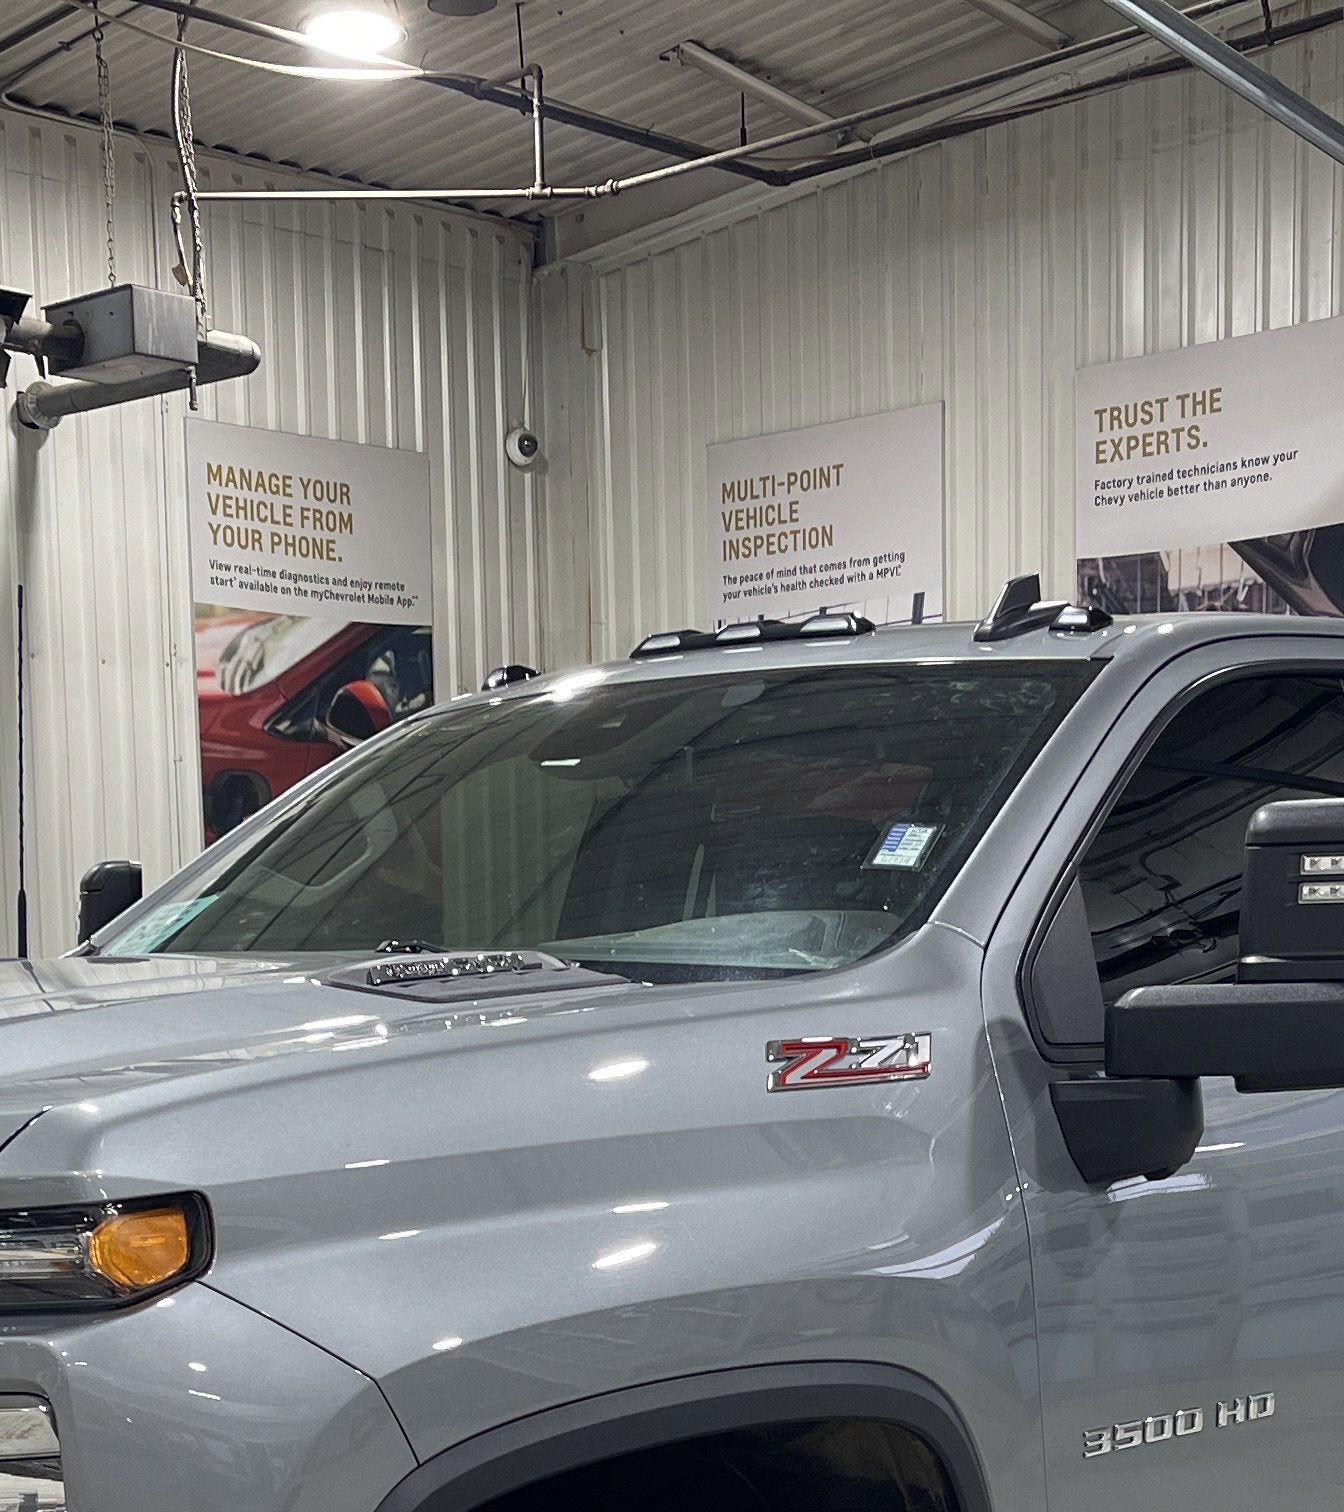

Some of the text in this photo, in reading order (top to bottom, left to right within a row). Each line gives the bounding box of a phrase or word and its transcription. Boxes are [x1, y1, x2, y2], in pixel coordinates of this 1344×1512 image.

[1095, 388, 1222, 432] TRUST THE
[1095, 424, 1208, 465] EXPERTS.
[207, 463, 351, 505] MANAGE YOUR
[721, 463, 844, 505] MULTI-POINT
[1094, 450, 1299, 491] Factory trained technicians know your
[1094, 472, 1272, 507] Chevy vehicle better than anyone.
[207, 492, 353, 534] VEHICLE FROM
[721, 500, 800, 533] VEHICLE
[208, 522, 342, 562] YOUR PHONE.
[722, 524, 834, 562] INSPECTION
[208, 559, 405, 592] View real-time diagnostics and enjoy remote
[722, 552, 906, 587] The peace of mind that comes from getting
[722, 590, 742, 603] your
[743, 583, 778, 597] vehicle's
[780, 579, 807, 593] health
[809, 573, 845, 589] checked
[846, 570, 866, 584] with
[868, 571, 874, 581] a
[238, 580, 278, 594] available
[280, 586, 292, 596] on
[293, 582, 309, 598] the
[367, 588, 395, 606] Mobile
[765, 1031, 932, 1093] Z71
[1082, 1391, 1275, 1458] 3500 HD
